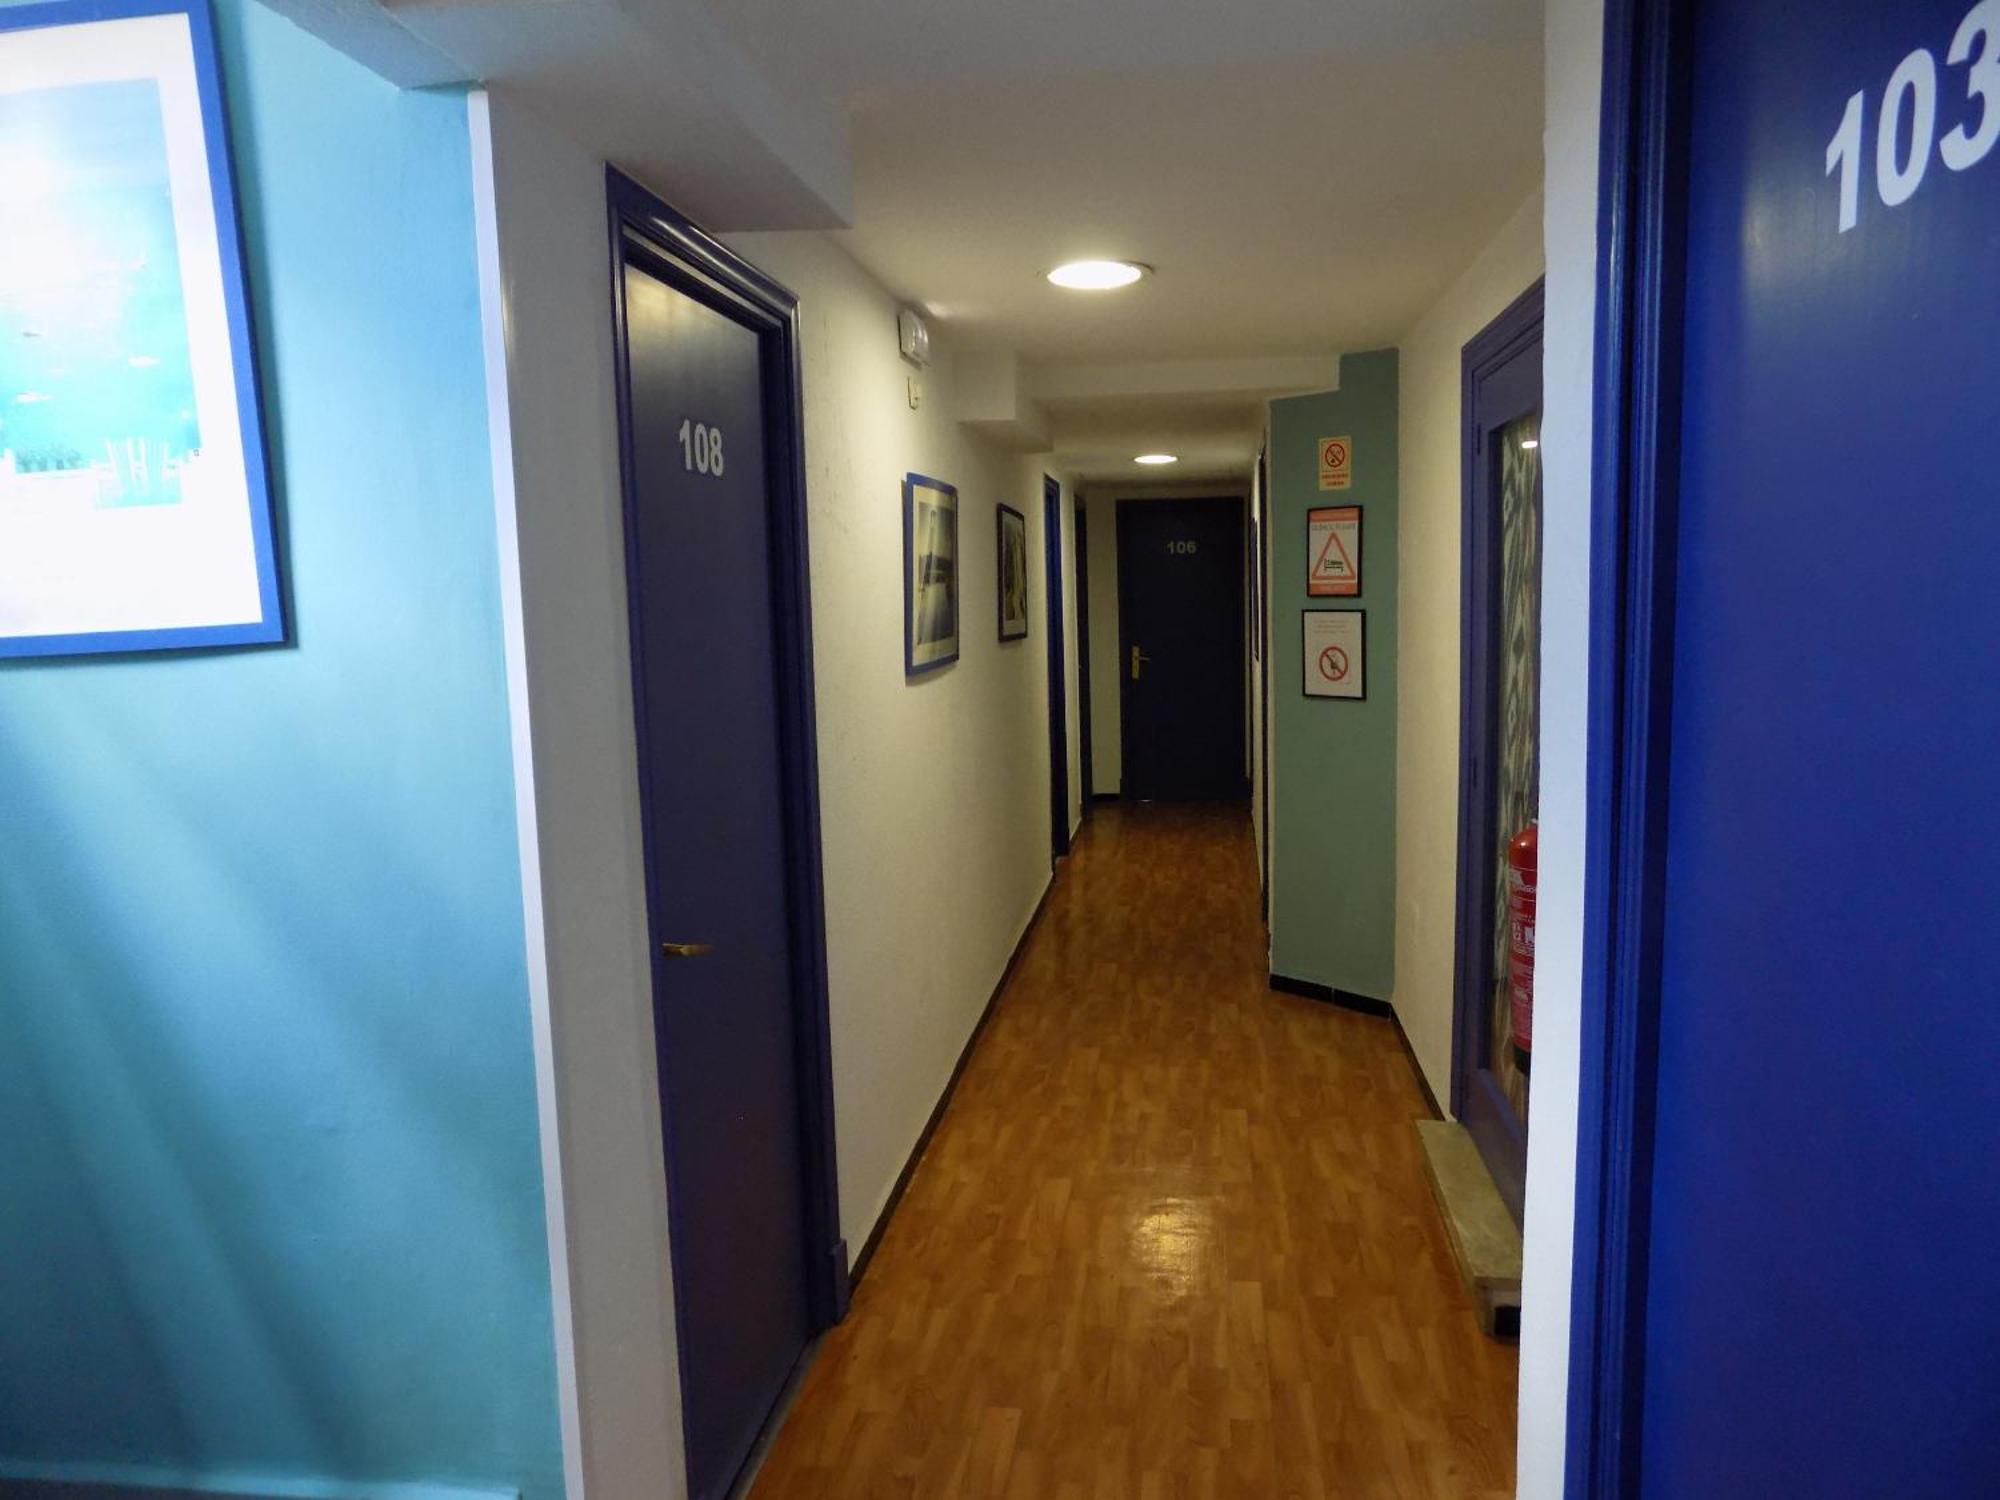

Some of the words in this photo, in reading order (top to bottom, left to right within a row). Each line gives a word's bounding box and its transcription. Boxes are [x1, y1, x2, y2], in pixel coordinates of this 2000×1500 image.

[1825, 0, 2000, 234] 103
[679, 418, 724, 477] 108
[1167, 541, 1197, 555] 106
